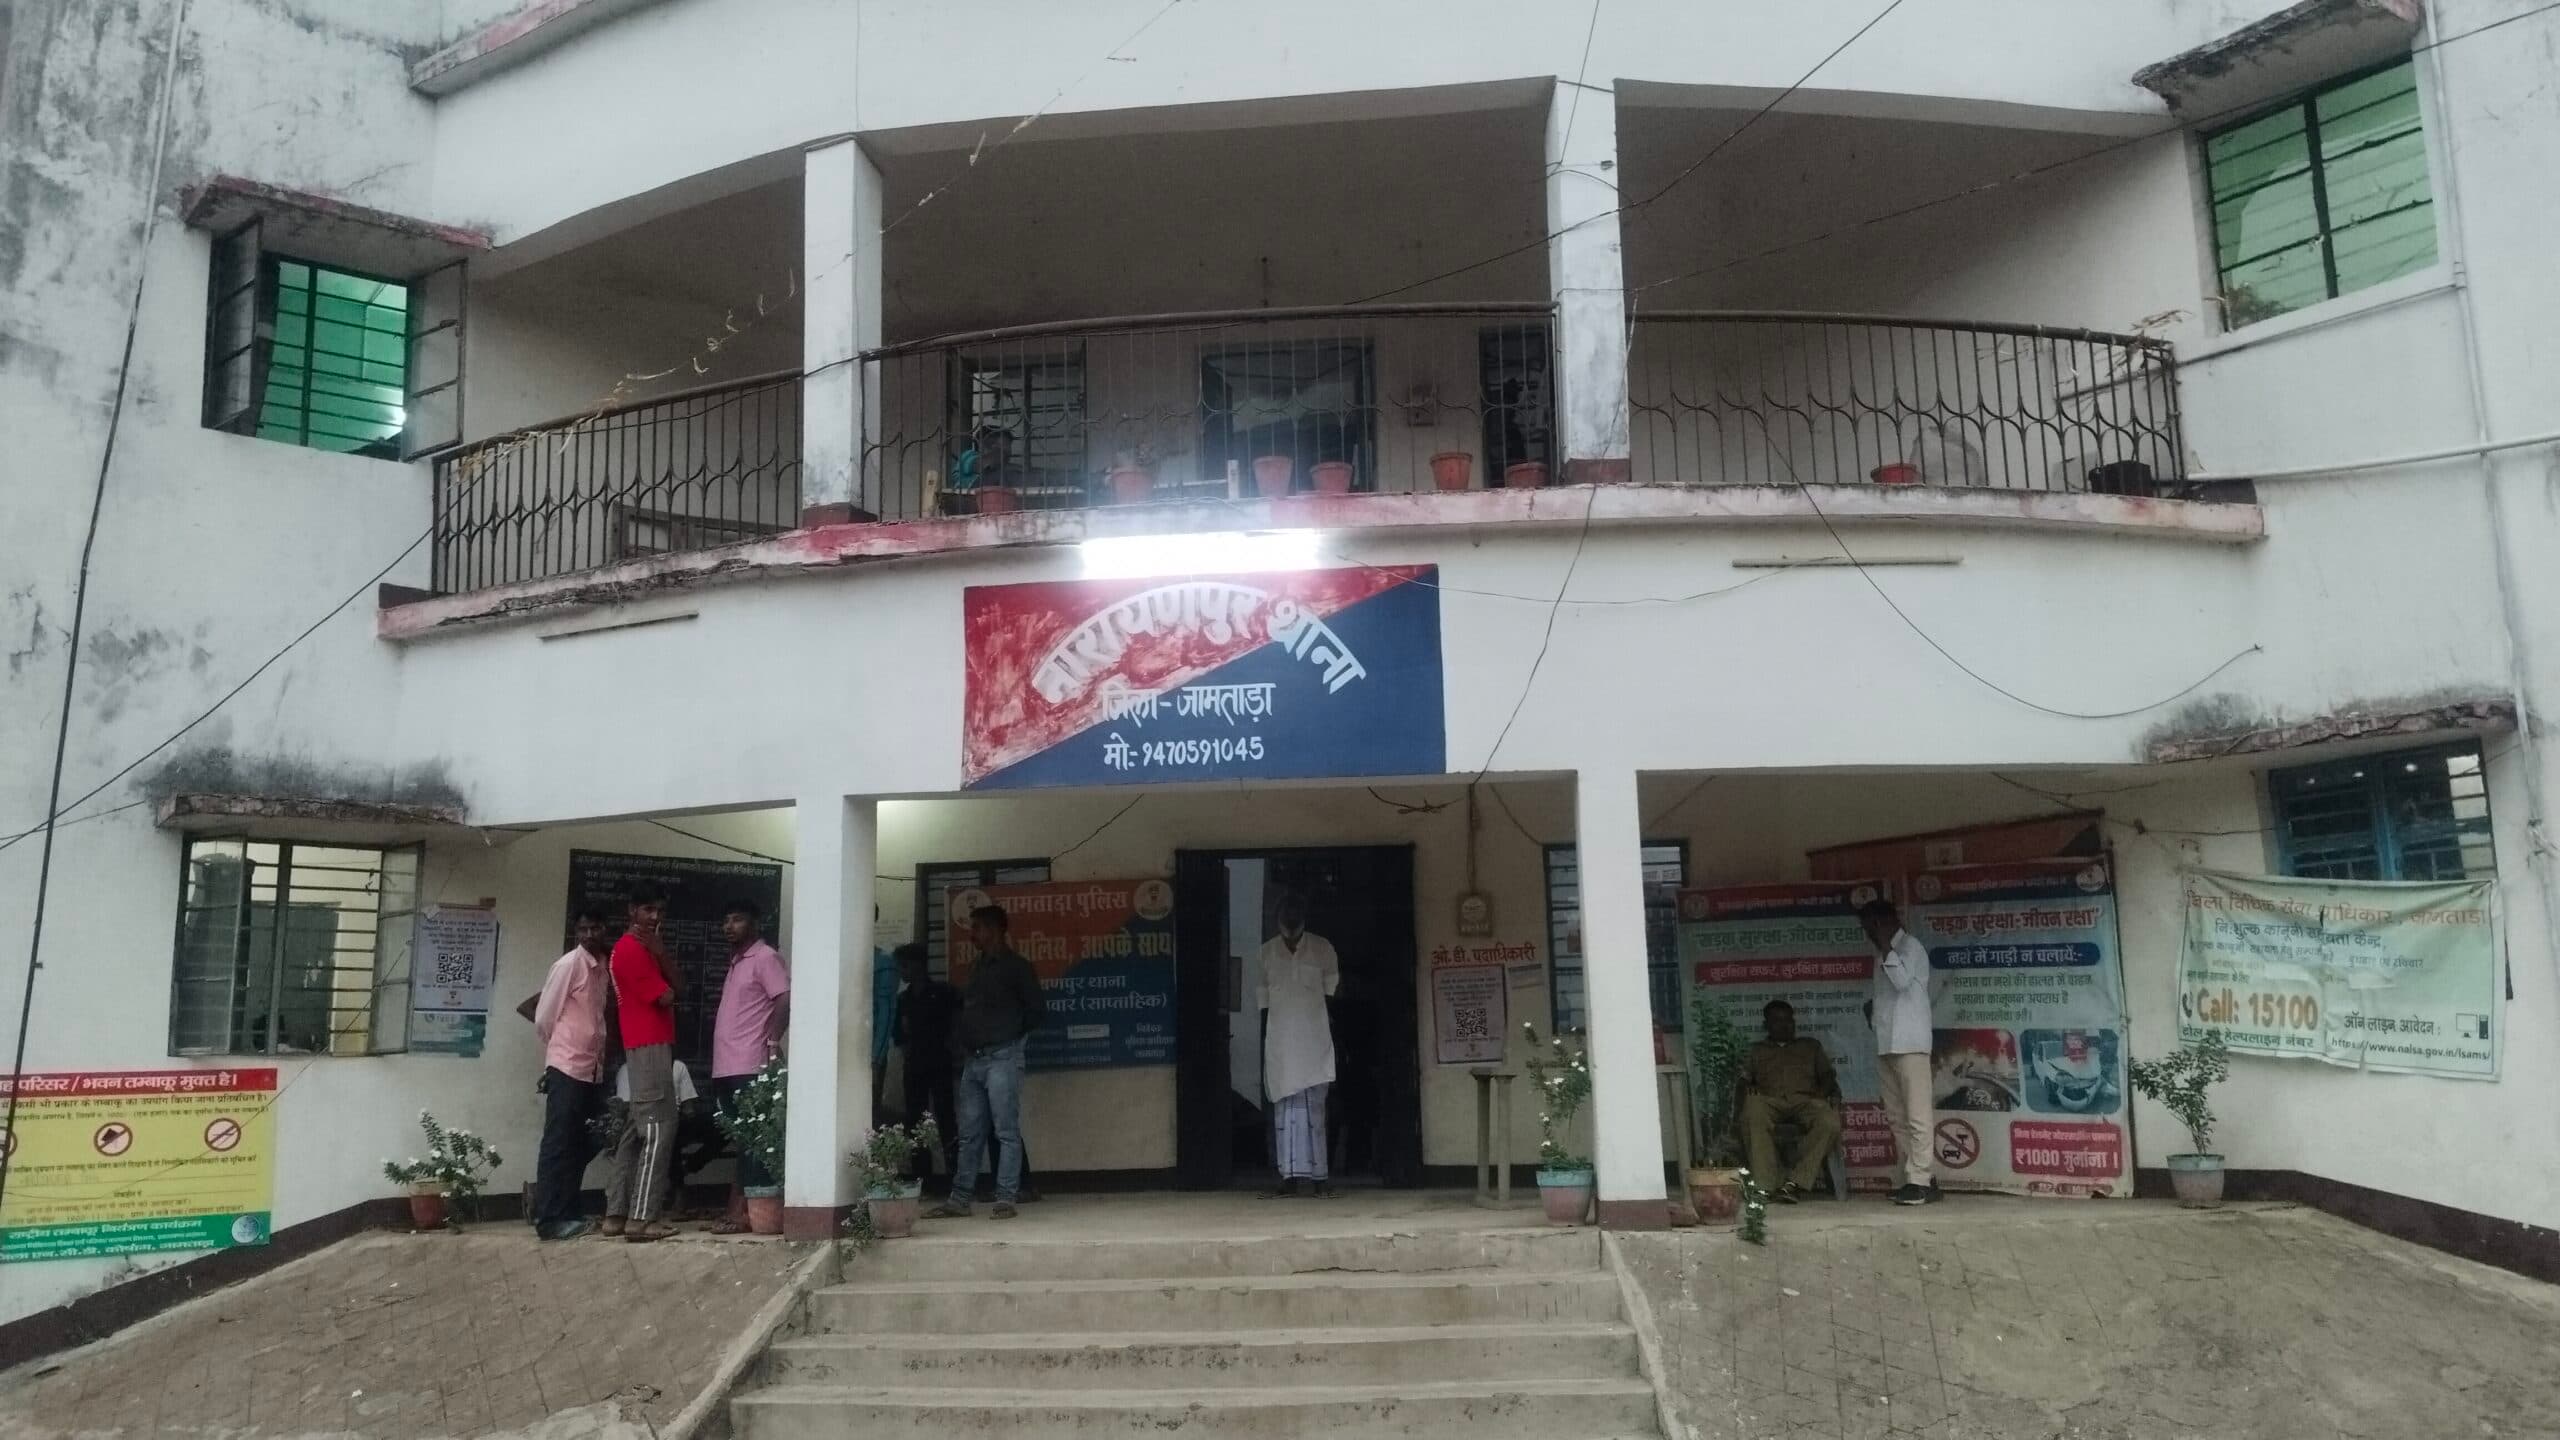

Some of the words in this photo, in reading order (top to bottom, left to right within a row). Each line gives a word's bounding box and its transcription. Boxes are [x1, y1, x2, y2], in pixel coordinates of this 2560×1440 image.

[1031, 581, 1268, 704] नारायणपुर
[1268, 596, 1366, 694] थाना
[1077, 886, 1129, 917] पुलिस
[2230, 891, 2275, 912] विधिक
[1081, 928, 1131, 959] आपके
[1138, 929, 1173, 956] साथ
[1946, 949, 1971, 964] नशे
[1974, 947, 1990, 963] में
[1990, 946, 2018, 967] गाड़ी
[2021, 950, 2033, 963] न
[1088, 975, 1126, 989] थाना
[1080, 991, 1168, 1010] (साप्ताहिक)
[2197, 988, 2240, 1024] Call:
[2248, 992, 2319, 1031] 15100
[18, 1075, 69, 1091] परिसर
[82, 1077, 121, 1091] भवन
[124, 1075, 177, 1092] तम्बाकू
[179, 1075, 216, 1091] मुक्त
[2061, 1146, 2108, 1173] जुर्माना
